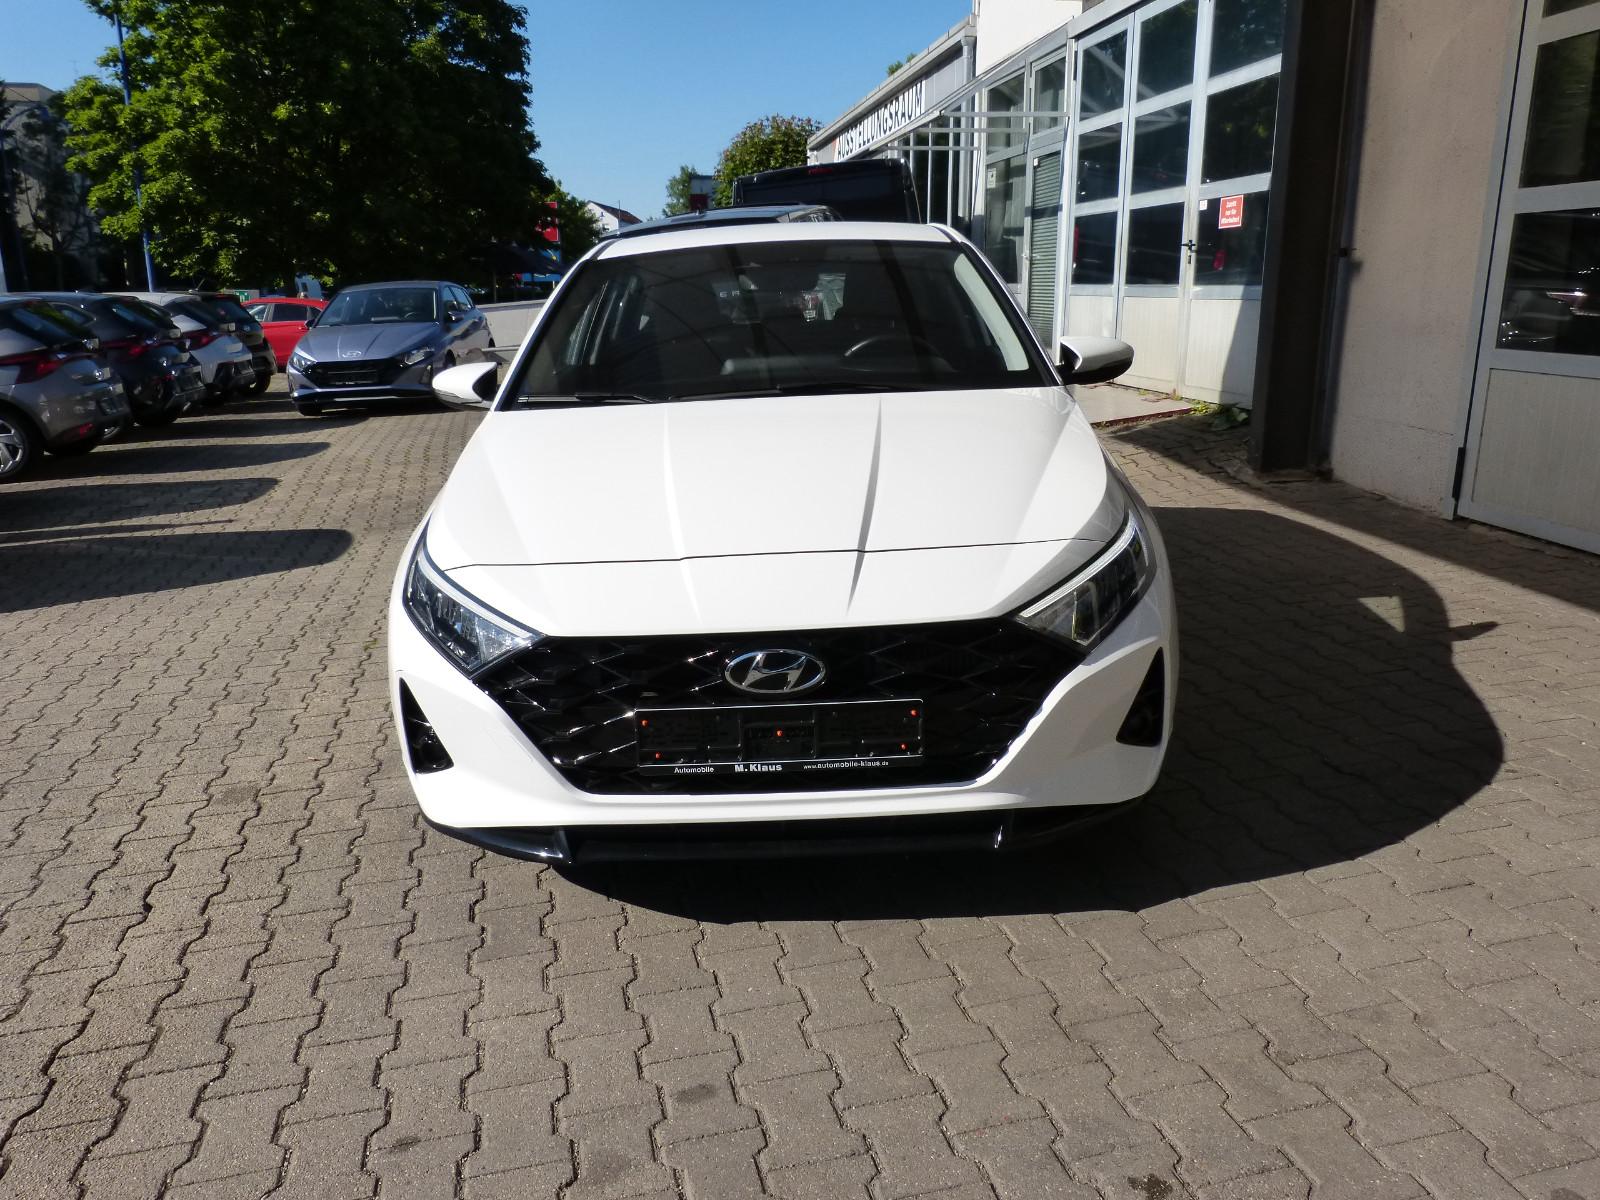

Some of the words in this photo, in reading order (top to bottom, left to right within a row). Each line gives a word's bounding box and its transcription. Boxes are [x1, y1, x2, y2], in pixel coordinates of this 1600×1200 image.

[837, 80, 923, 159] AUSSTELLUNGSRAUM
[674, 765, 715, 774] Automobile
[803, 760, 889, 769] www.automobile-klaus.de
